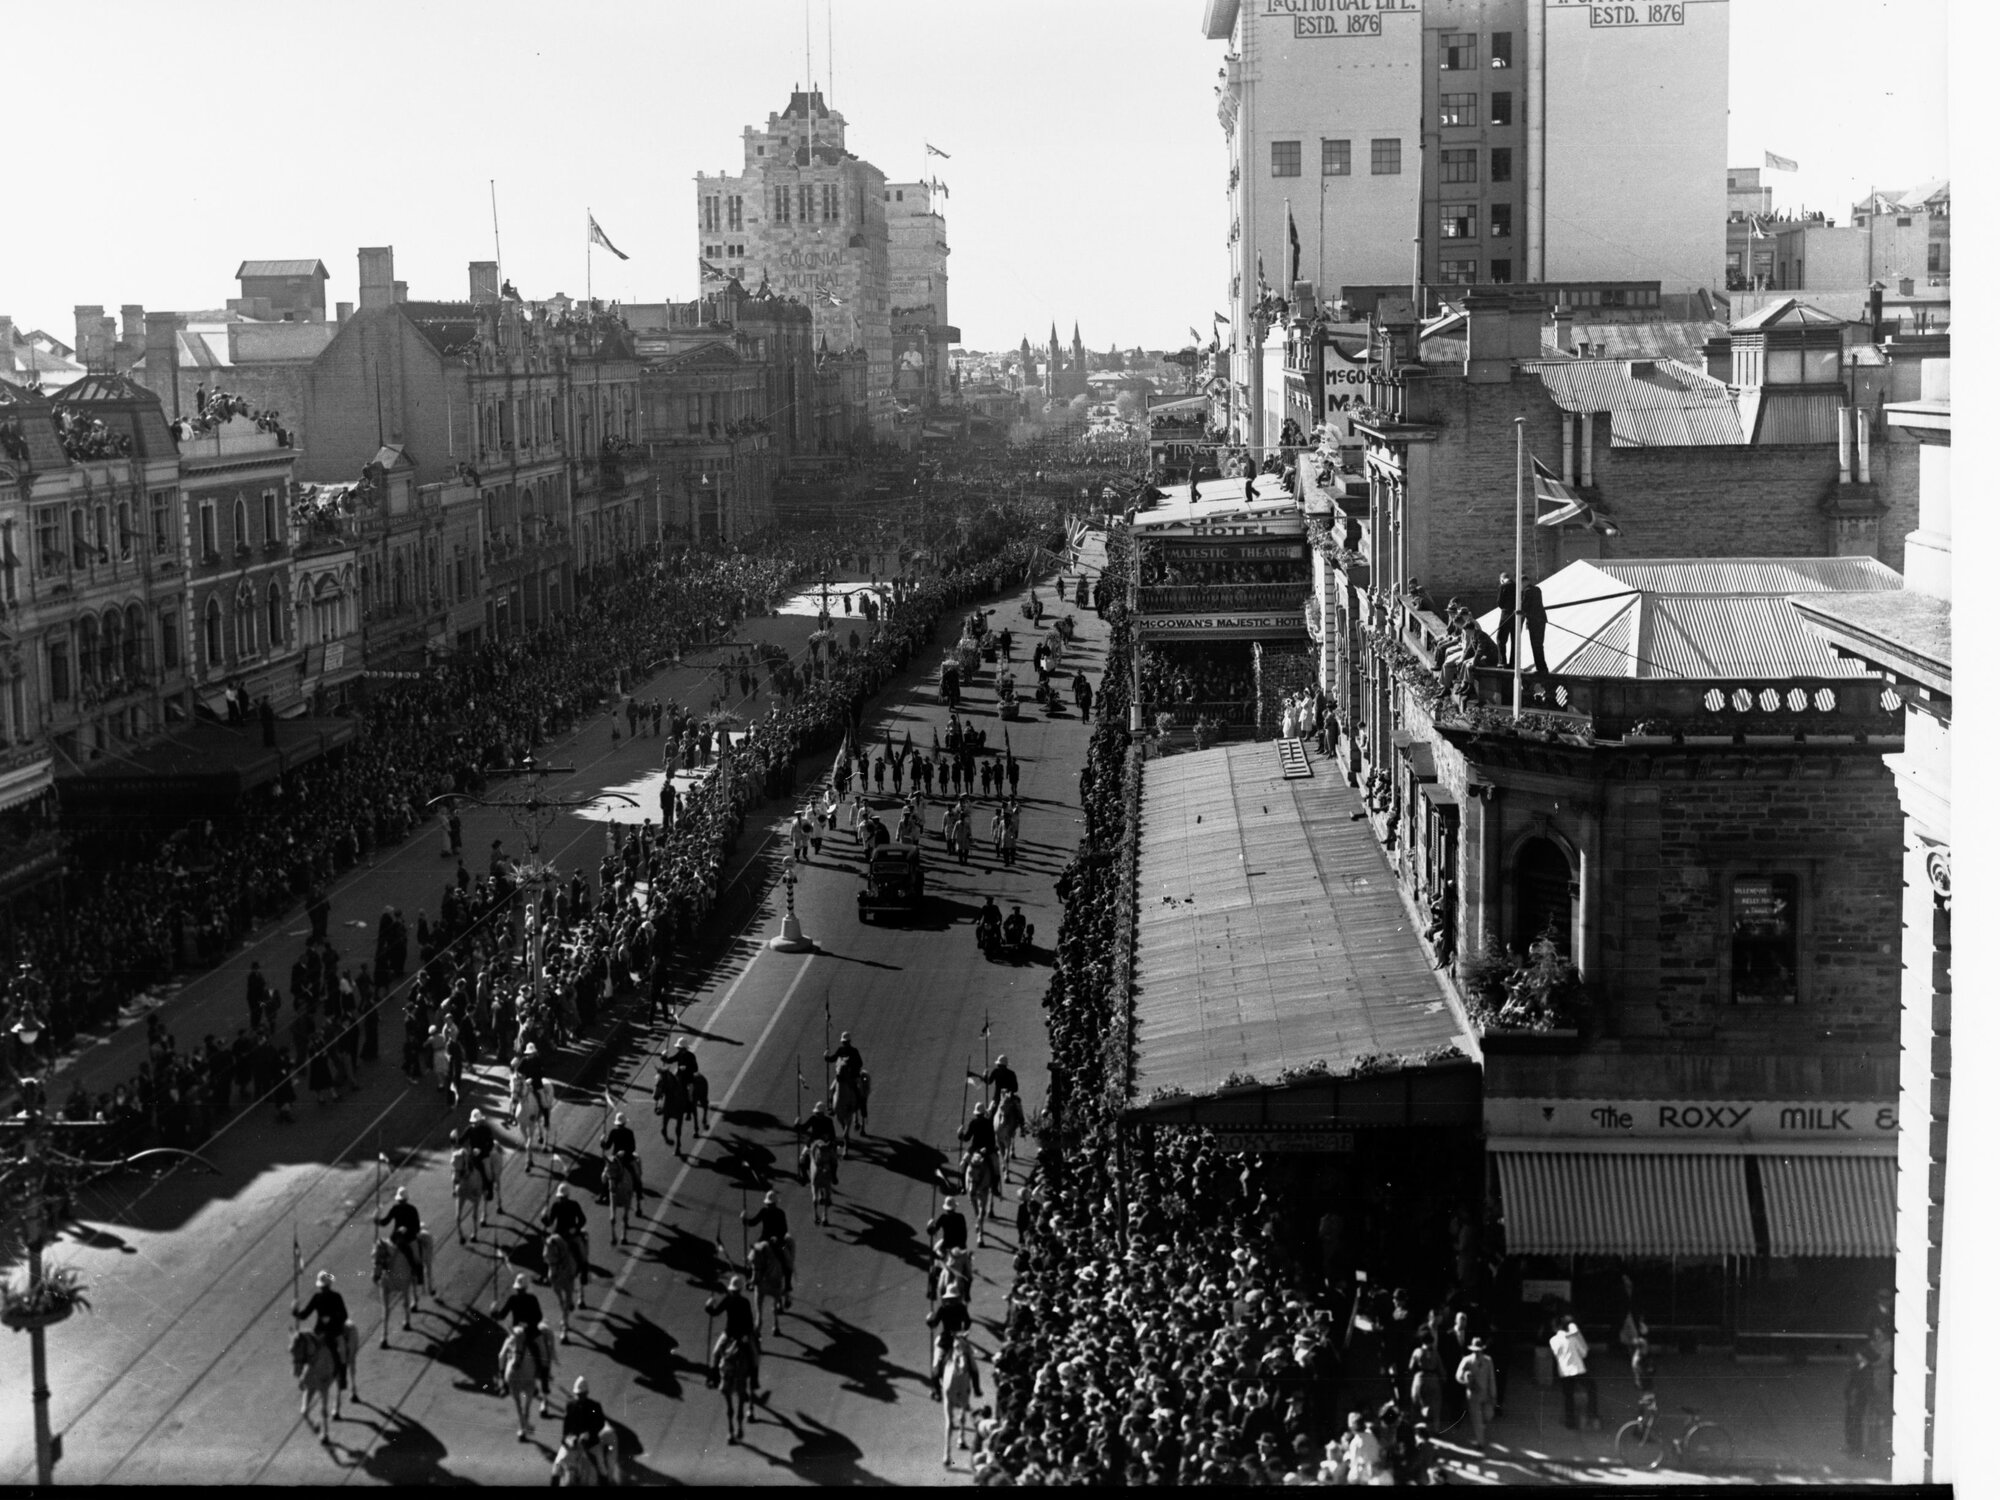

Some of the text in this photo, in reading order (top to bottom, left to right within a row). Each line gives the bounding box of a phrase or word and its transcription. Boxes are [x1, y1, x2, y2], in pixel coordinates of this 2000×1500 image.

[1591, 5, 1680, 24] ESTD. 1876
[1297, 14, 1380, 34] ESTD. 1876
[780, 251, 847, 267] COLONIAL
[783, 273, 843, 288] MUTUAL
[1326, 369, 1367, 385] McGO
[1145, 508, 1297, 532] MAJESTIC
[1193, 526, 1276, 536] HOTEL
[1170, 547, 1230, 559] MAJESTIC
[1139, 617, 1306, 629] McGOWAN'S MAJESTIC HOTE
[1590, 1107, 1634, 1129] The
[1659, 1107, 1752, 1128] ROXY
[1780, 1108, 1853, 1131] MILK
